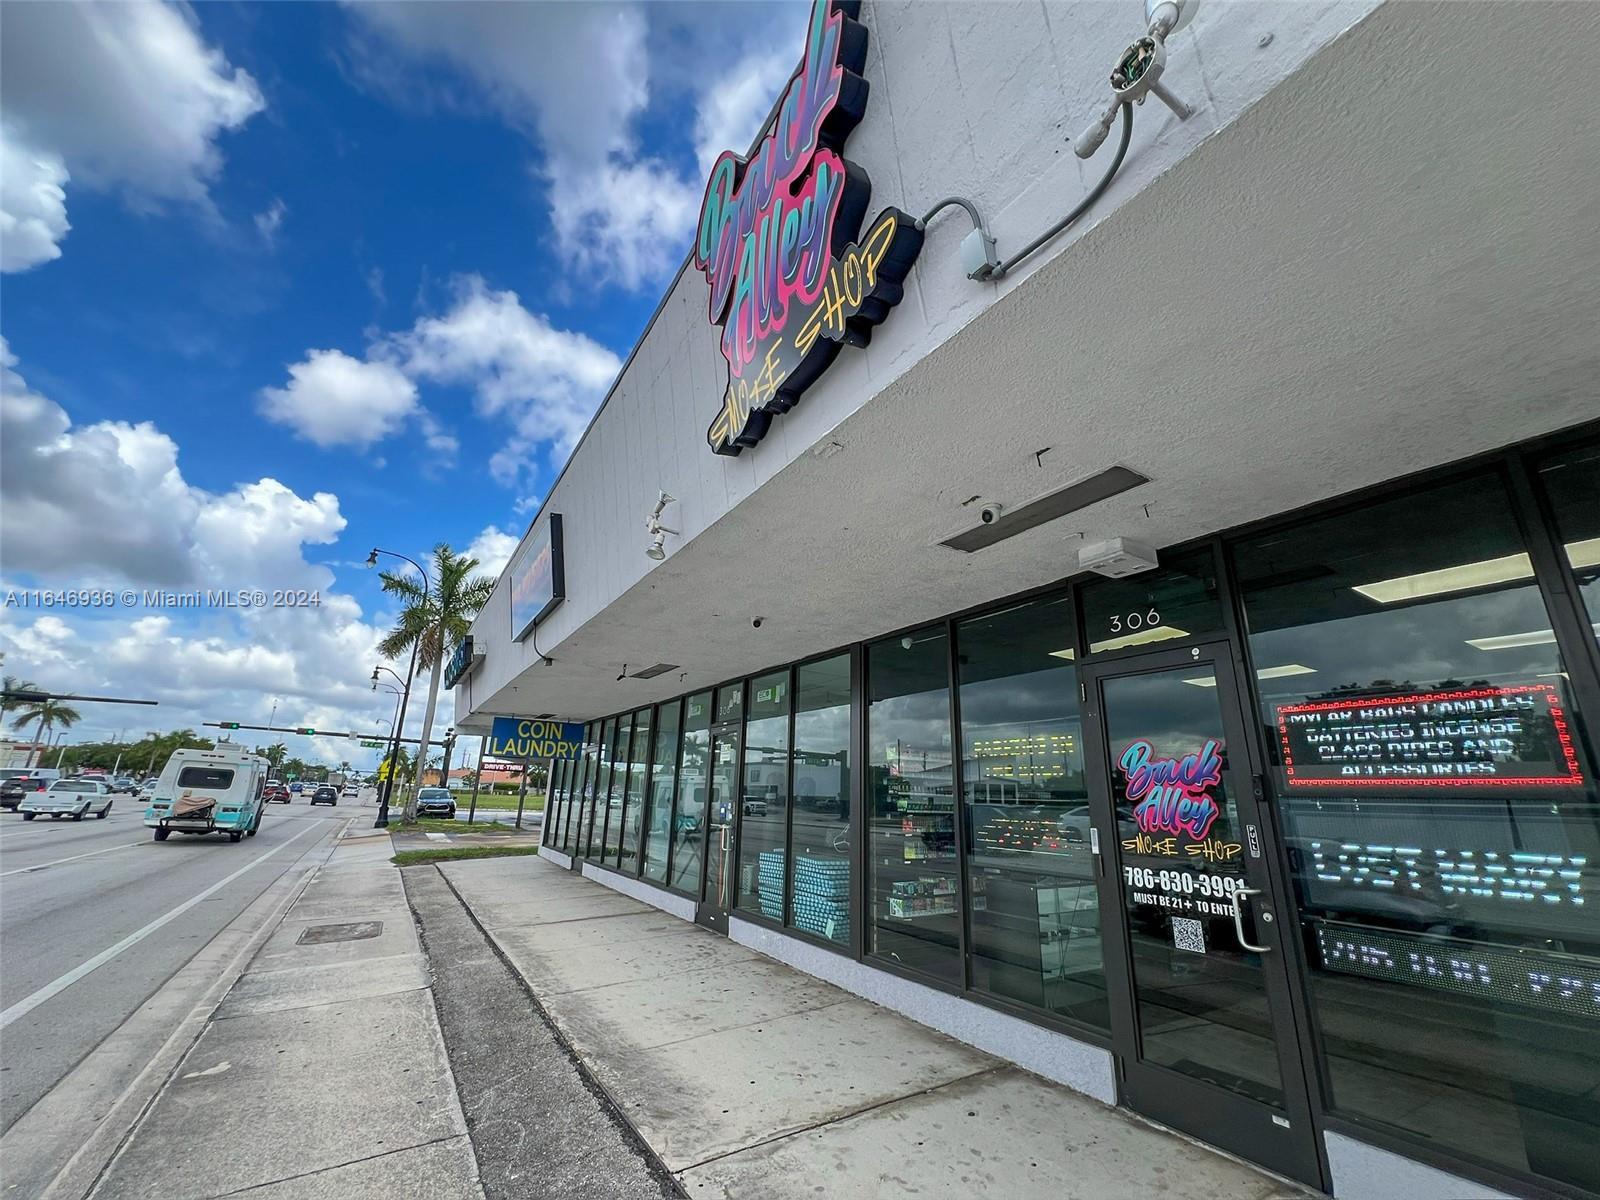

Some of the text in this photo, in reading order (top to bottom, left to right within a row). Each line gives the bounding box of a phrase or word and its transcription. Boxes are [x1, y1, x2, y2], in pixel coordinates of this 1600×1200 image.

[724, 157, 842, 364] Alley
[709, 216, 896, 445] SMOKE SHOP
[1109, 607, 1160, 633] 306
[518, 720, 563, 740] COIN
[492, 737, 580, 758] LAUNDRY
[483, 763, 524, 771] DRIVE-THRU
[1119, 739, 1221, 798] Back
[1136, 785, 1217, 836] Alley
[1121, 833, 1242, 862] SMOKE SHOP
[1248, 826, 1259, 851] PULL
[1124, 866, 1247, 901] 786-830-3991
[1133, 892, 1158, 906] MUST
[1159, 895, 1171, 907] BE
[1196, 900, 1210, 914] TO
[1210, 902, 1241, 918] ENTE
